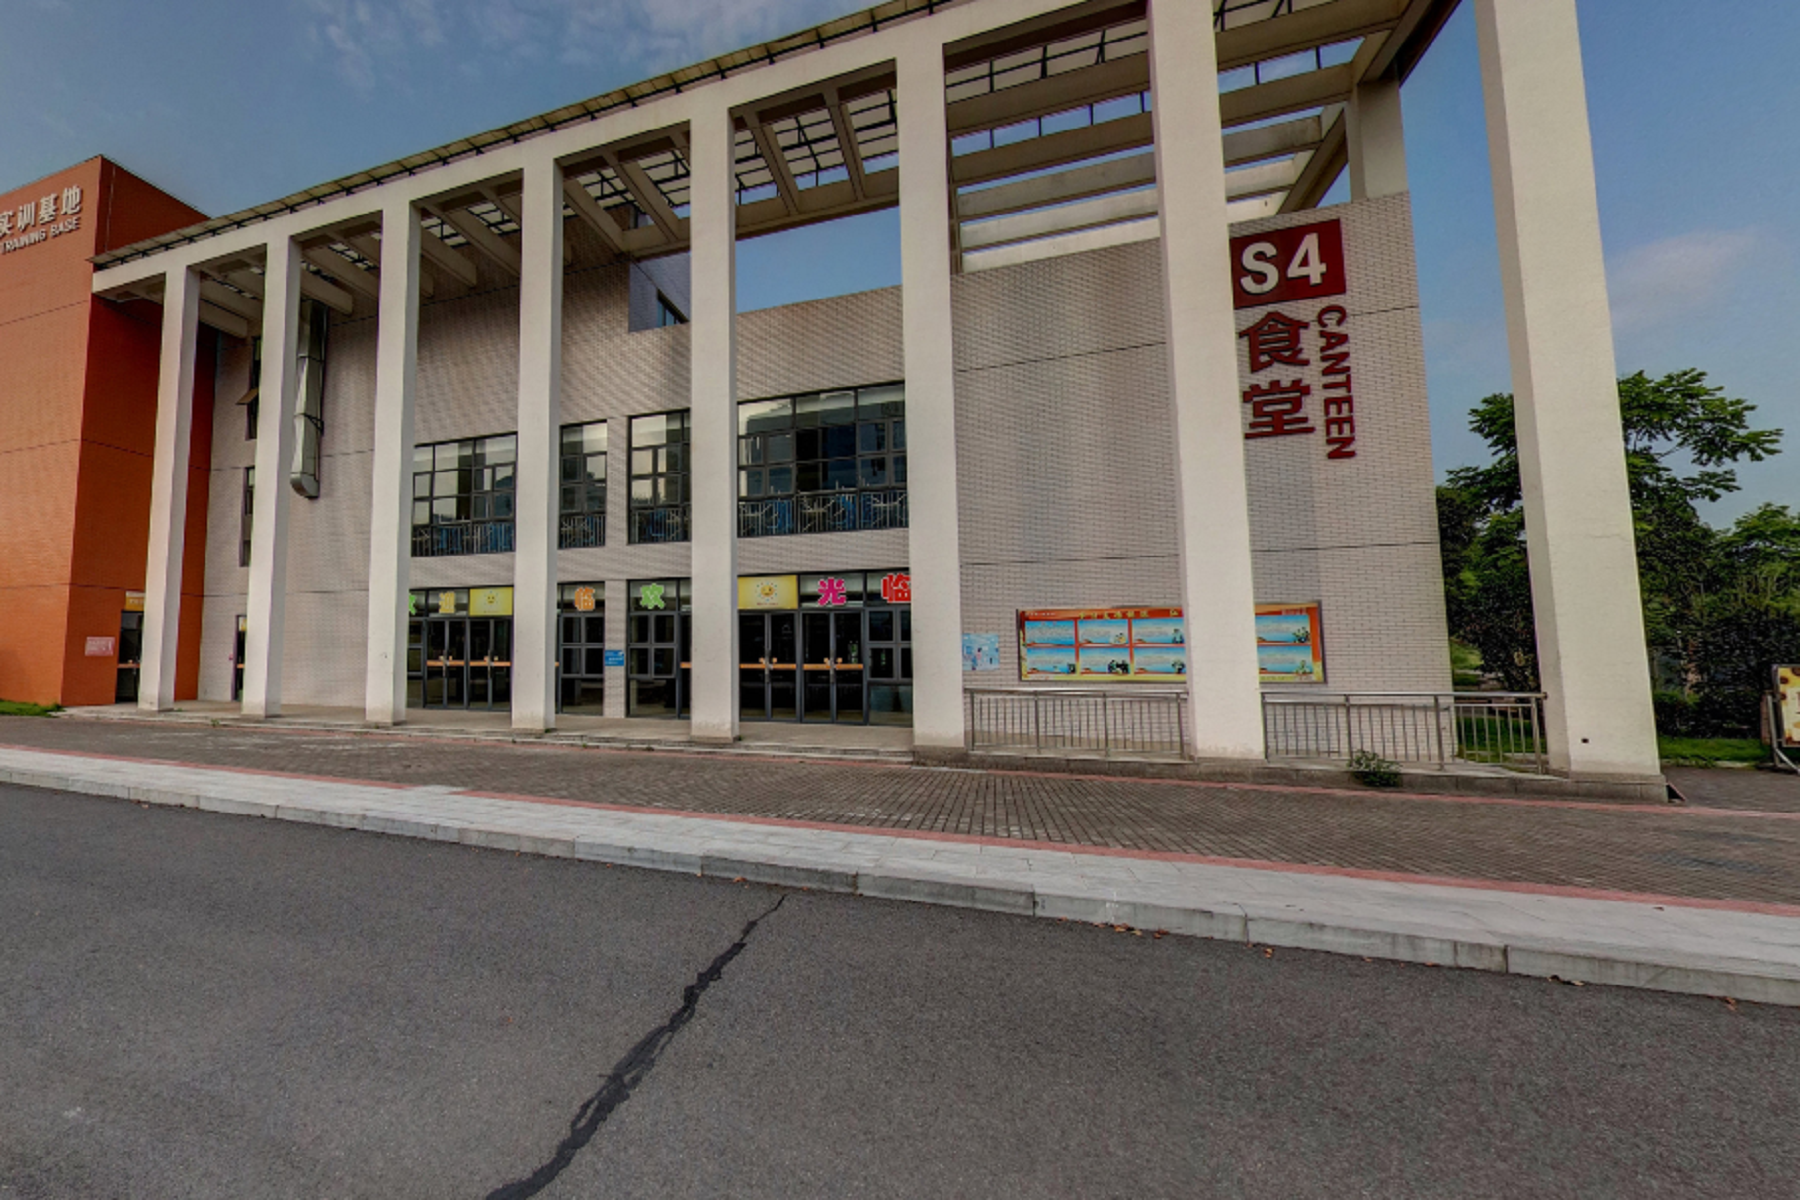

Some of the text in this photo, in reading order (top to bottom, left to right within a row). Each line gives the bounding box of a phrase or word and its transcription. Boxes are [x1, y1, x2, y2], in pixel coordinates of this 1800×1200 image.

[0, 185, 81, 238] 实训基地
[51, 217, 80, 238] BASE
[1240, 232, 1327, 296] S4
[1238, 311, 1316, 440] 食堂
[1317, 304, 1357, 460] CANTEEN
[574, 586, 595, 612] 临
[640, 583, 665, 609] 欢
